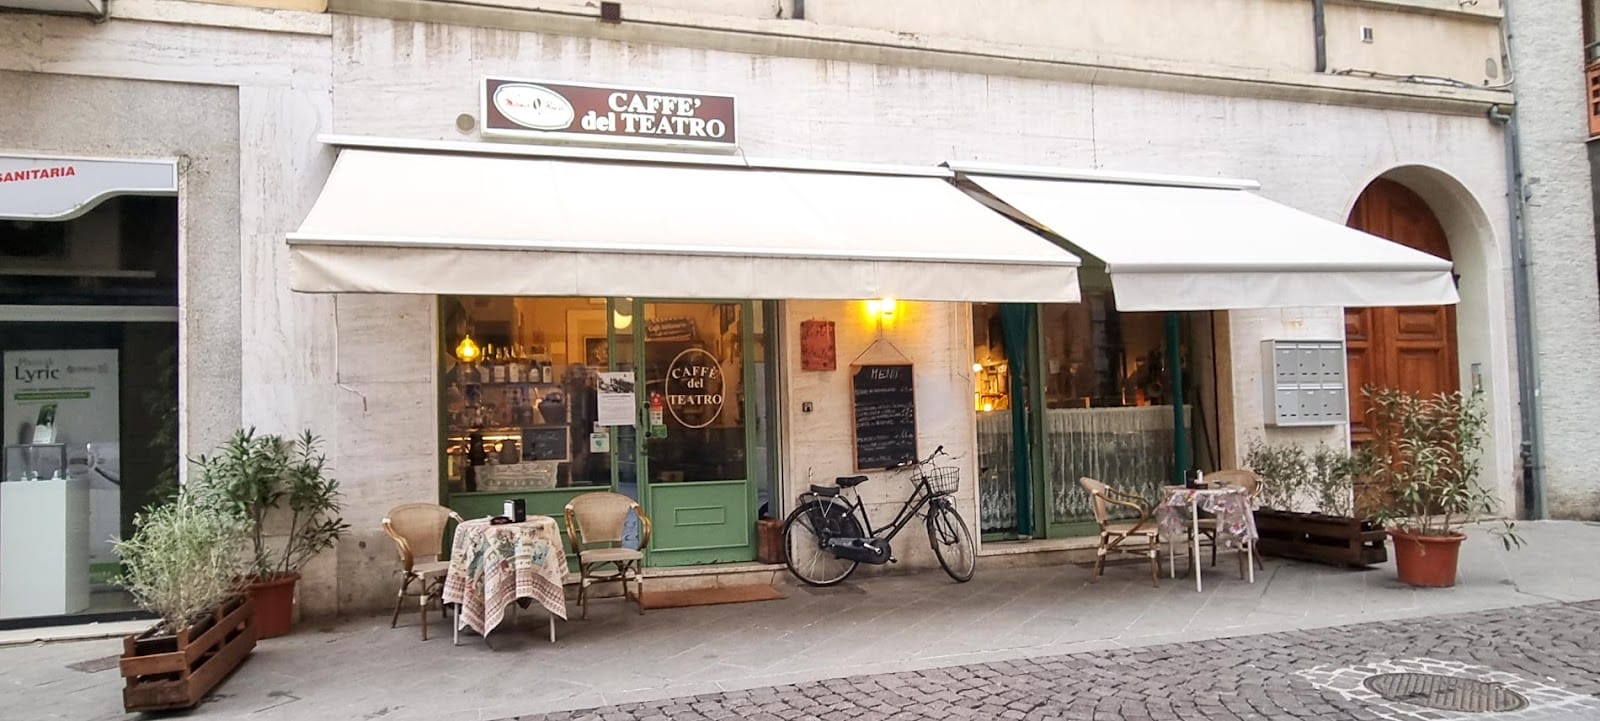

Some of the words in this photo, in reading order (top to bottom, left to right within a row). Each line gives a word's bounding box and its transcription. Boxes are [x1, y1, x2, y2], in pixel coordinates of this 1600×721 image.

[608, 92, 701, 116] CAFFE'
[581, 110, 616, 131] del
[621, 113, 726, 138] TEATRO
[14, 364, 60, 383] Lyric
[687, 378, 704, 388] del
[668, 394, 722, 405] TEATRO
